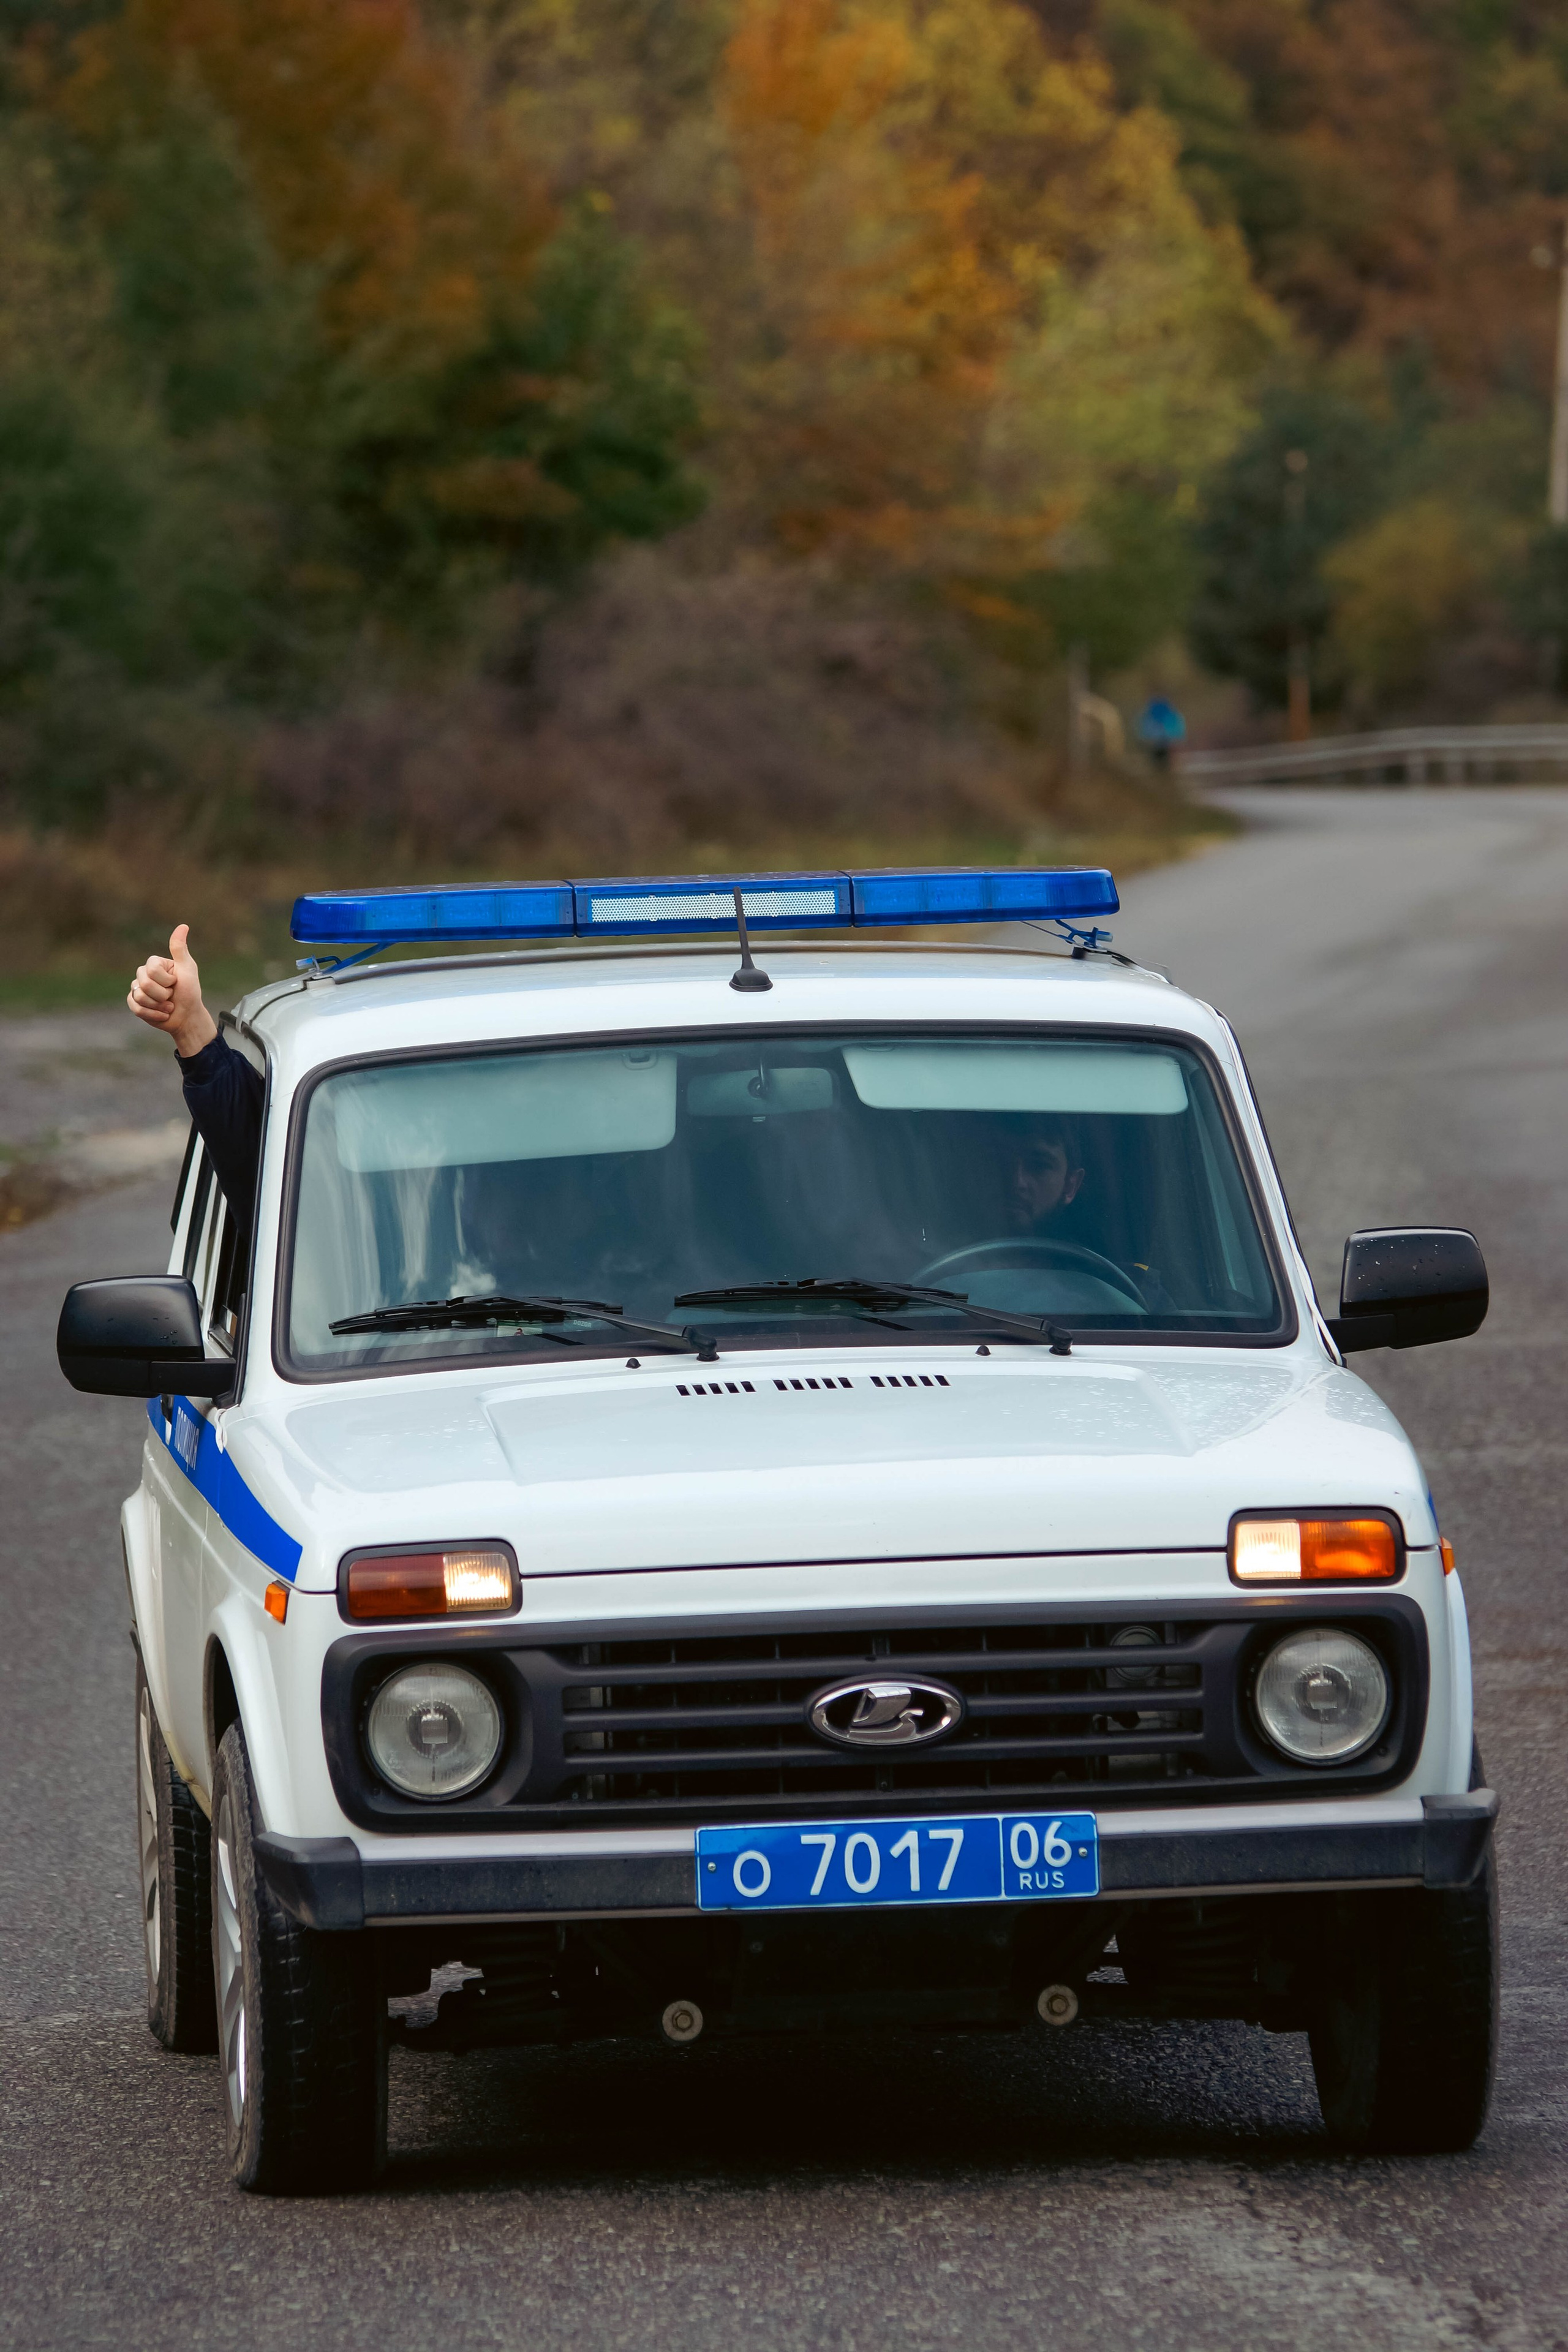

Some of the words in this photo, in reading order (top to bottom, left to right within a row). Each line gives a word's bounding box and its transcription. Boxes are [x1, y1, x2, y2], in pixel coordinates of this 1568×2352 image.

[801, 1829, 964, 1896] 7017
[1010, 1821, 1072, 1869] 06
[1020, 1871, 1065, 1890] RUS
